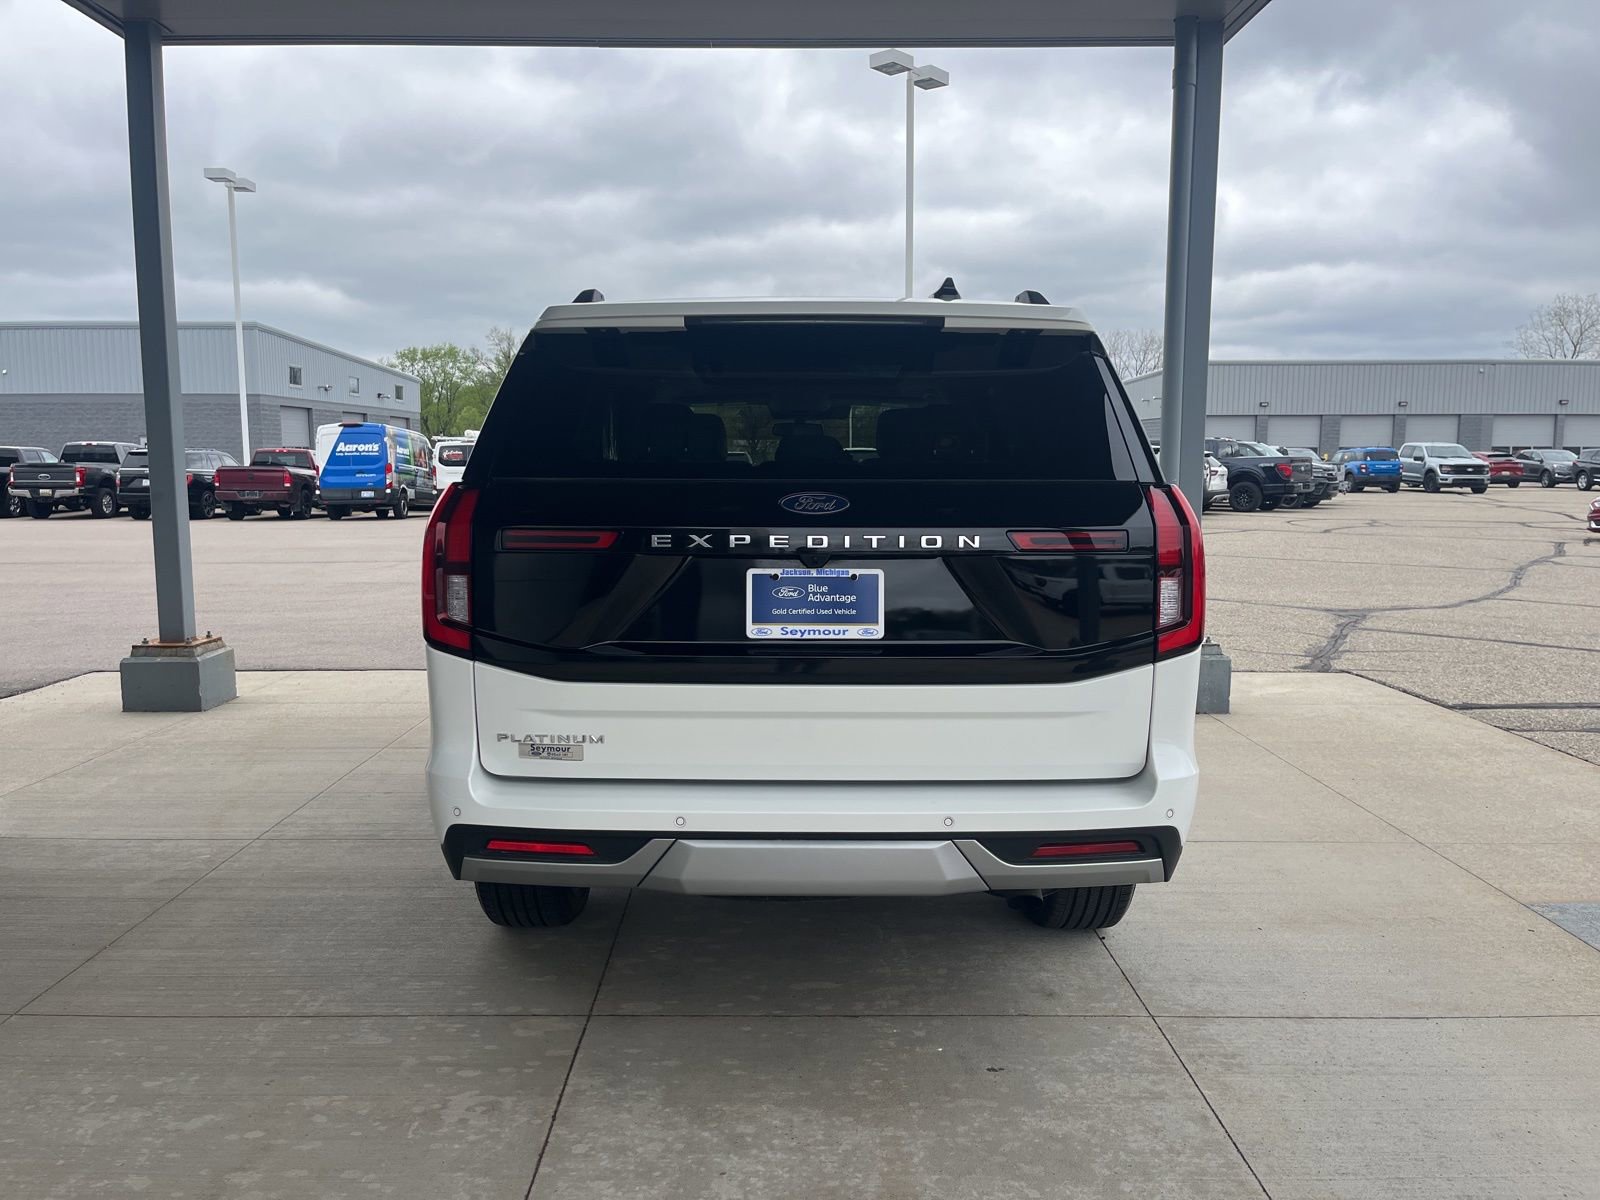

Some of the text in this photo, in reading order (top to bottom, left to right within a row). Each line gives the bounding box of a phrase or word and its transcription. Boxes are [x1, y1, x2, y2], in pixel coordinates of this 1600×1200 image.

[336, 442, 380, 452] Aaron's
[794, 495, 837, 511] Ford
[651, 534, 981, 549] EXPEDITION
[816, 569, 850, 577] Michigan
[778, 588, 799, 597] Ford
[808, 584, 829, 592] Blue
[807, 594, 857, 603] Advantage
[780, 627, 849, 637] Seymour
[496, 733, 605, 744] PLATINUM
[530, 744, 571, 753] Seymour
